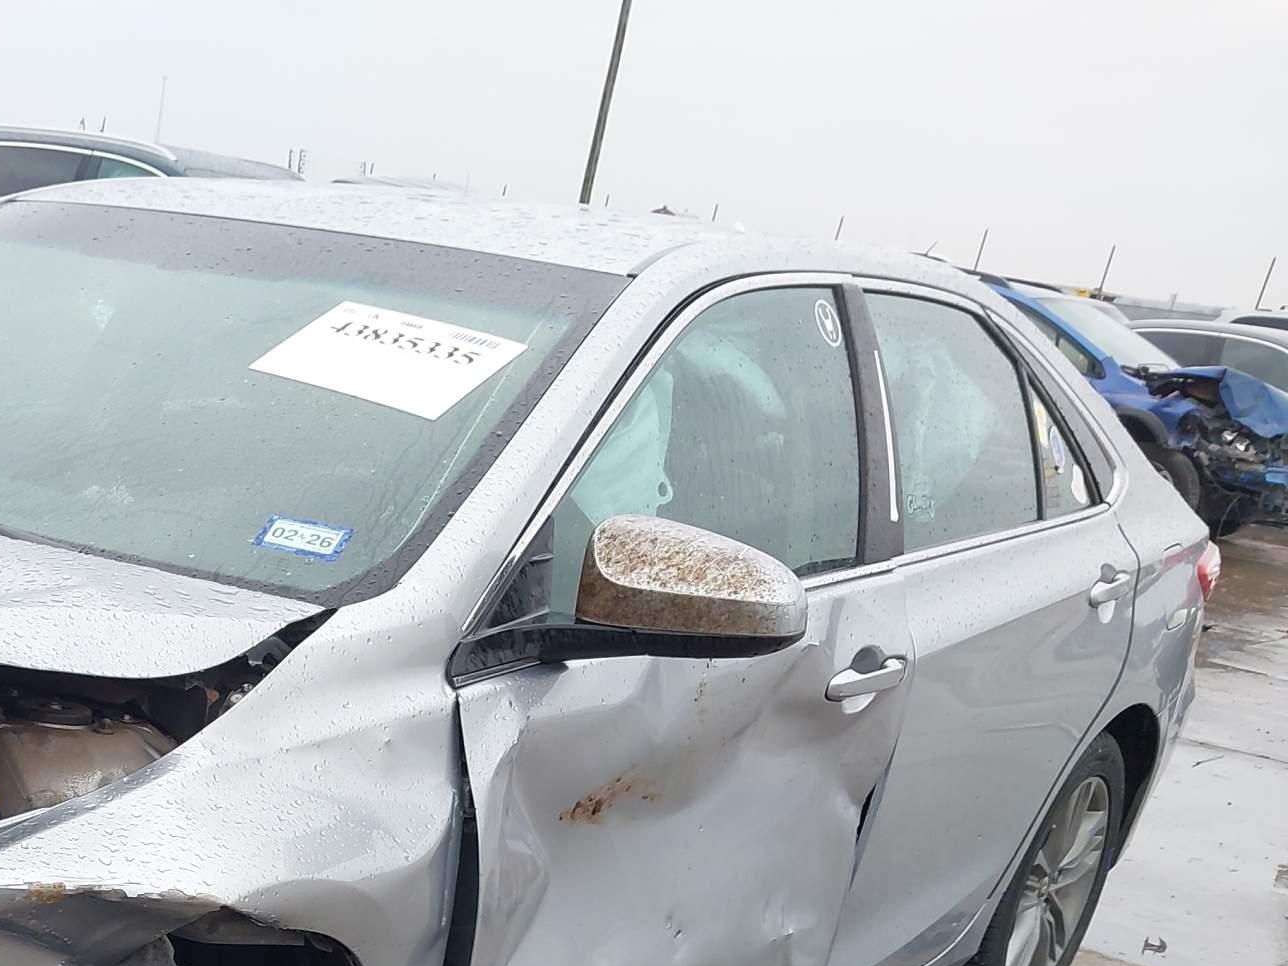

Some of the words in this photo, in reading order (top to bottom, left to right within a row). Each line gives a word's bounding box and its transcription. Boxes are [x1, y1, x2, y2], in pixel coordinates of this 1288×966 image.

[331, 321, 482, 365] 43835335
[271, 526, 299, 542] 02
[306, 533, 336, 549] 26
